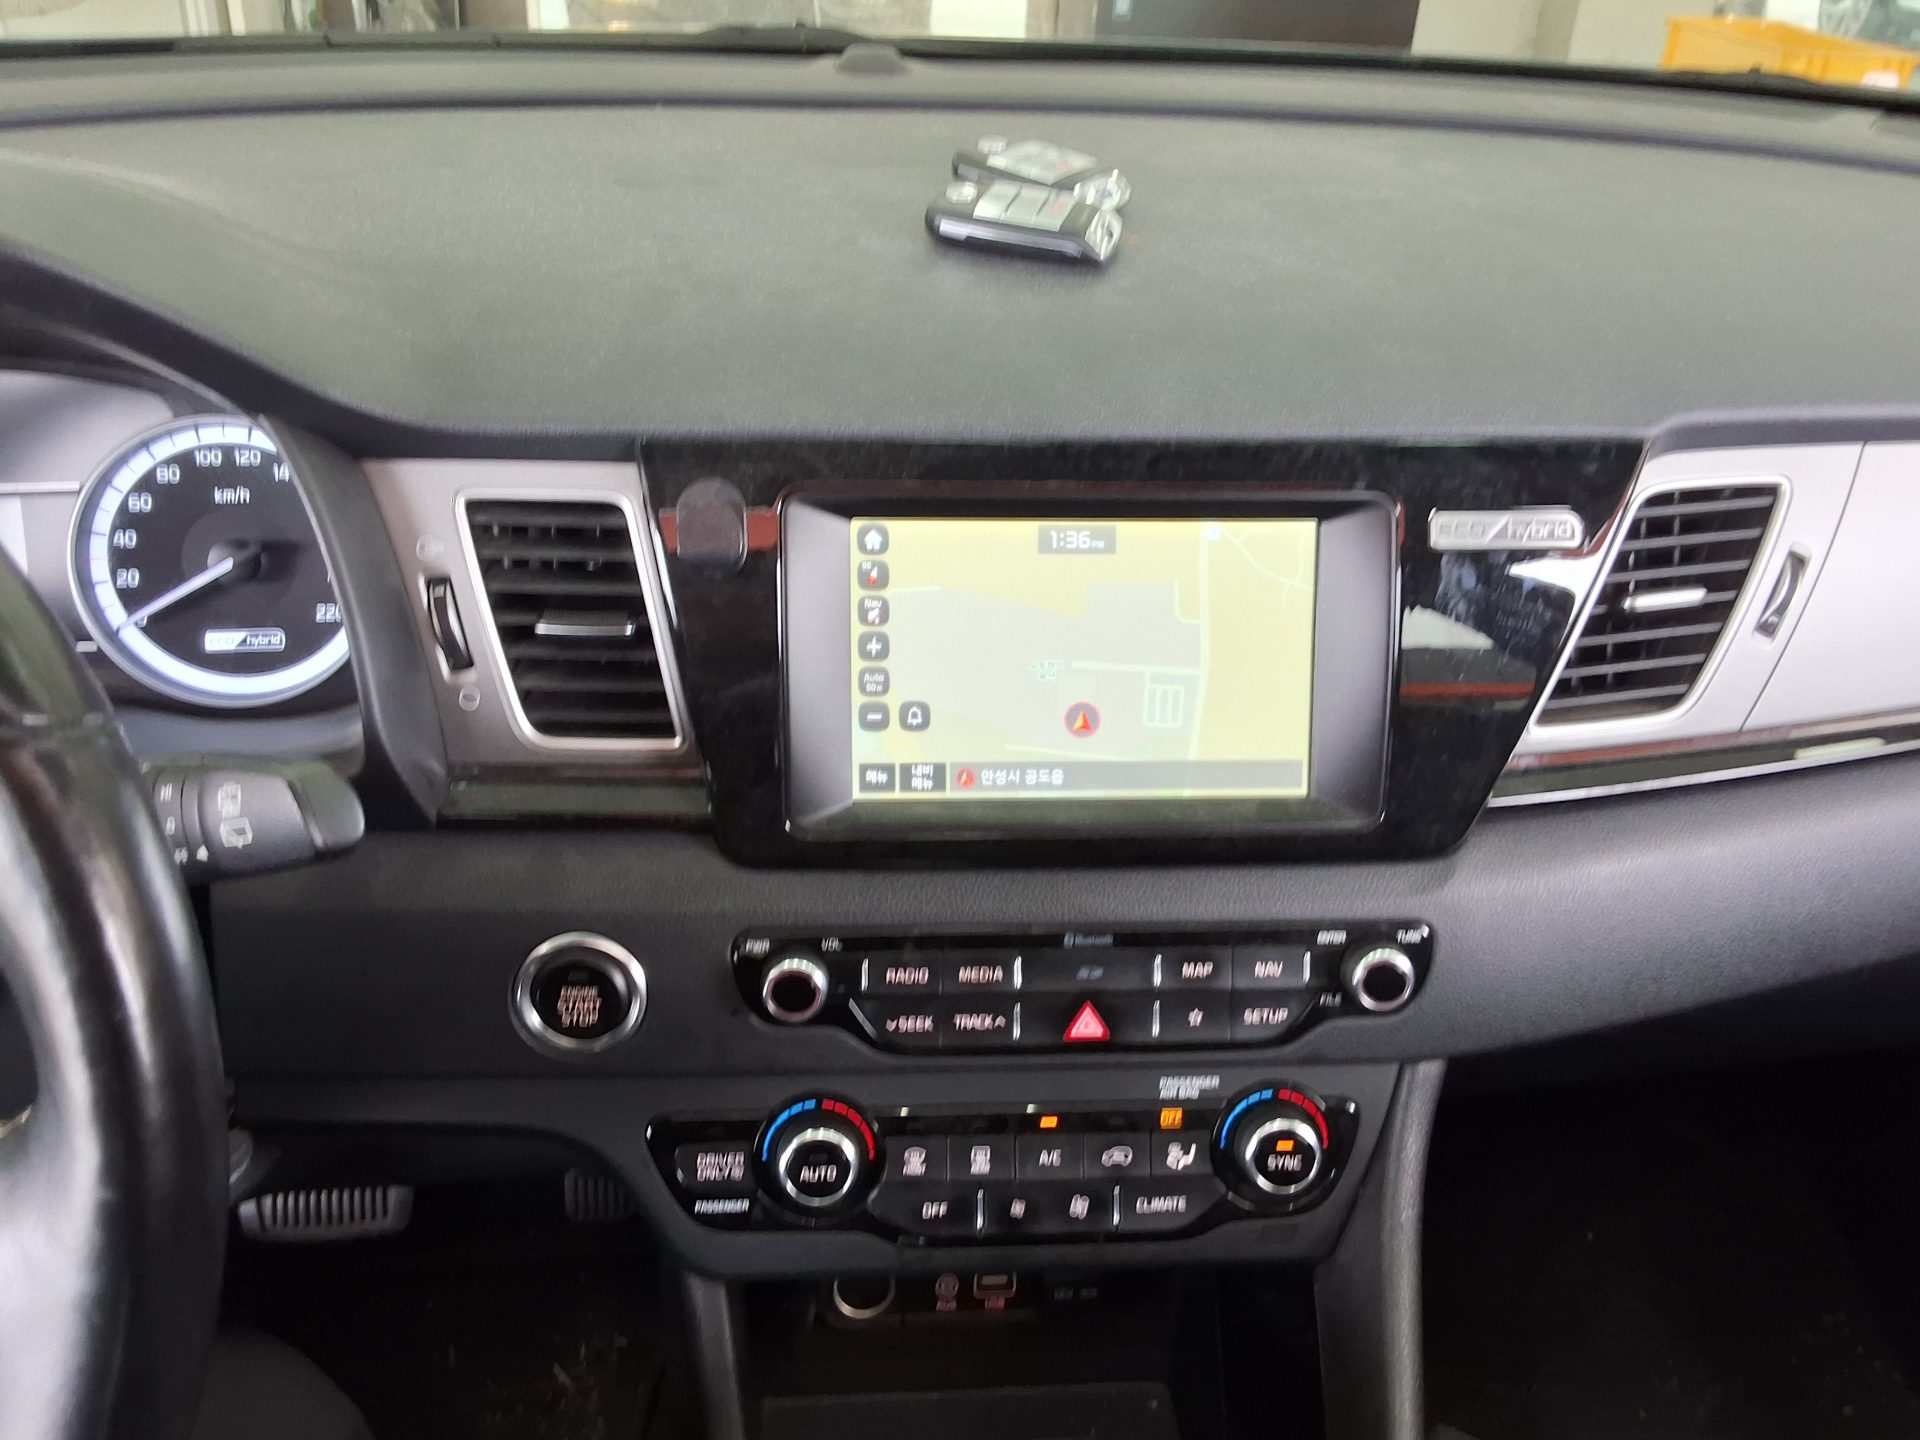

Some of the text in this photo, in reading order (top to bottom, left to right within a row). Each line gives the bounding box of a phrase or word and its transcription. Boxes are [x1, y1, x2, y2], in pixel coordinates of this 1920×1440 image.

[194, 449, 222, 467] 100
[234, 449, 261, 467] 120
[156, 464, 181, 484] 80
[272, 462, 290, 483] 14
[128, 492, 152, 512] 60
[214, 486, 250, 504] km/h
[113, 529, 137, 549] 40
[1050, 530, 1091, 549] 1:36
[1507, 517, 1576, 544] hybrid
[116, 568, 140, 588] 20
[864, 598, 883, 609] Nav
[246, 634, 282, 649] hybrid
[864, 673, 885, 684] Auto
[981, 768, 1065, 787] 안성시 공도읍
[822, 937, 843, 951] VOL
[886, 967, 930, 984] RADIO
[959, 966, 1004, 983] MEDIA
[1182, 961, 1214, 979] MAP
[1254, 961, 1284, 979] NAV
[898, 1015, 934, 1032] SEEK
[954, 1013, 994, 1031] TRACK
[1244, 1007, 1289, 1025] SETUP
[1159, 1074, 1220, 1090] PASSENGER
[1161, 1110, 1182, 1126] OFF
[696, 1152, 745, 1169] DRIVER
[1039, 1149, 1062, 1167] A/C
[1267, 1153, 1302, 1172] SYNC
[800, 1164, 837, 1183] AUTO
[694, 1198, 750, 1215] PASSENGER
[922, 1201, 948, 1220] OFF
[1136, 1195, 1187, 1214] CLIMATE
